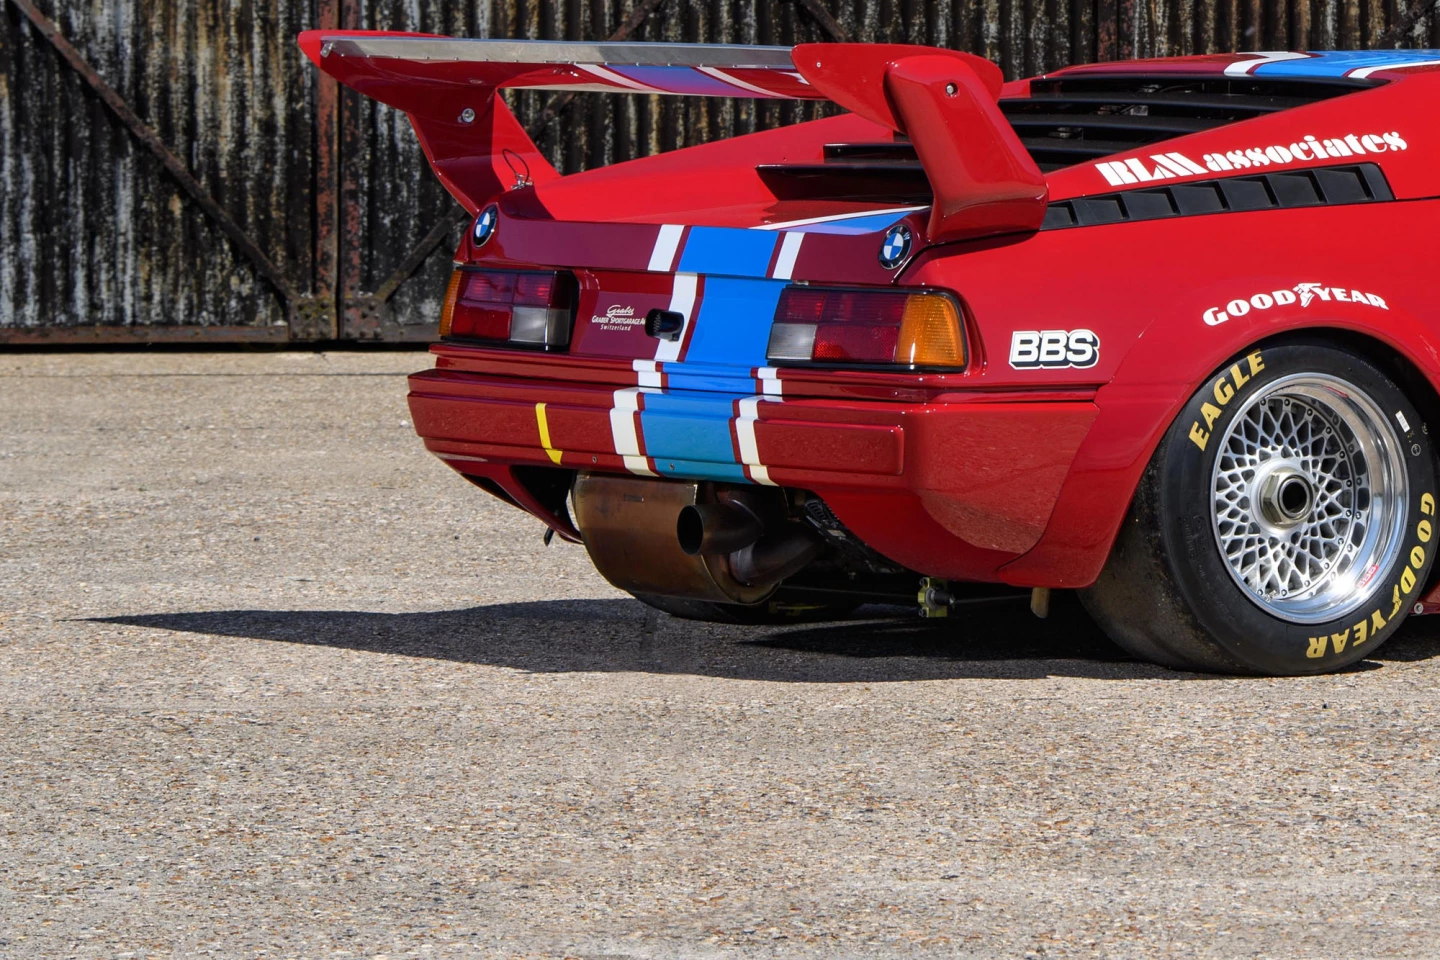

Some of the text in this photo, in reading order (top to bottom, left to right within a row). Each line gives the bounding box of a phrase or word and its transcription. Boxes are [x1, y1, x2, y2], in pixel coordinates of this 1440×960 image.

[1204, 131, 1408, 172] associates
[1202, 282, 1389, 327] GOODYEAR
[600, 324, 631, 332] Switzerland
[1009, 329, 1099, 369] BBS
[1188, 348, 1266, 452] EAGLE
[1305, 492, 1436, 659] GOODYEAR
